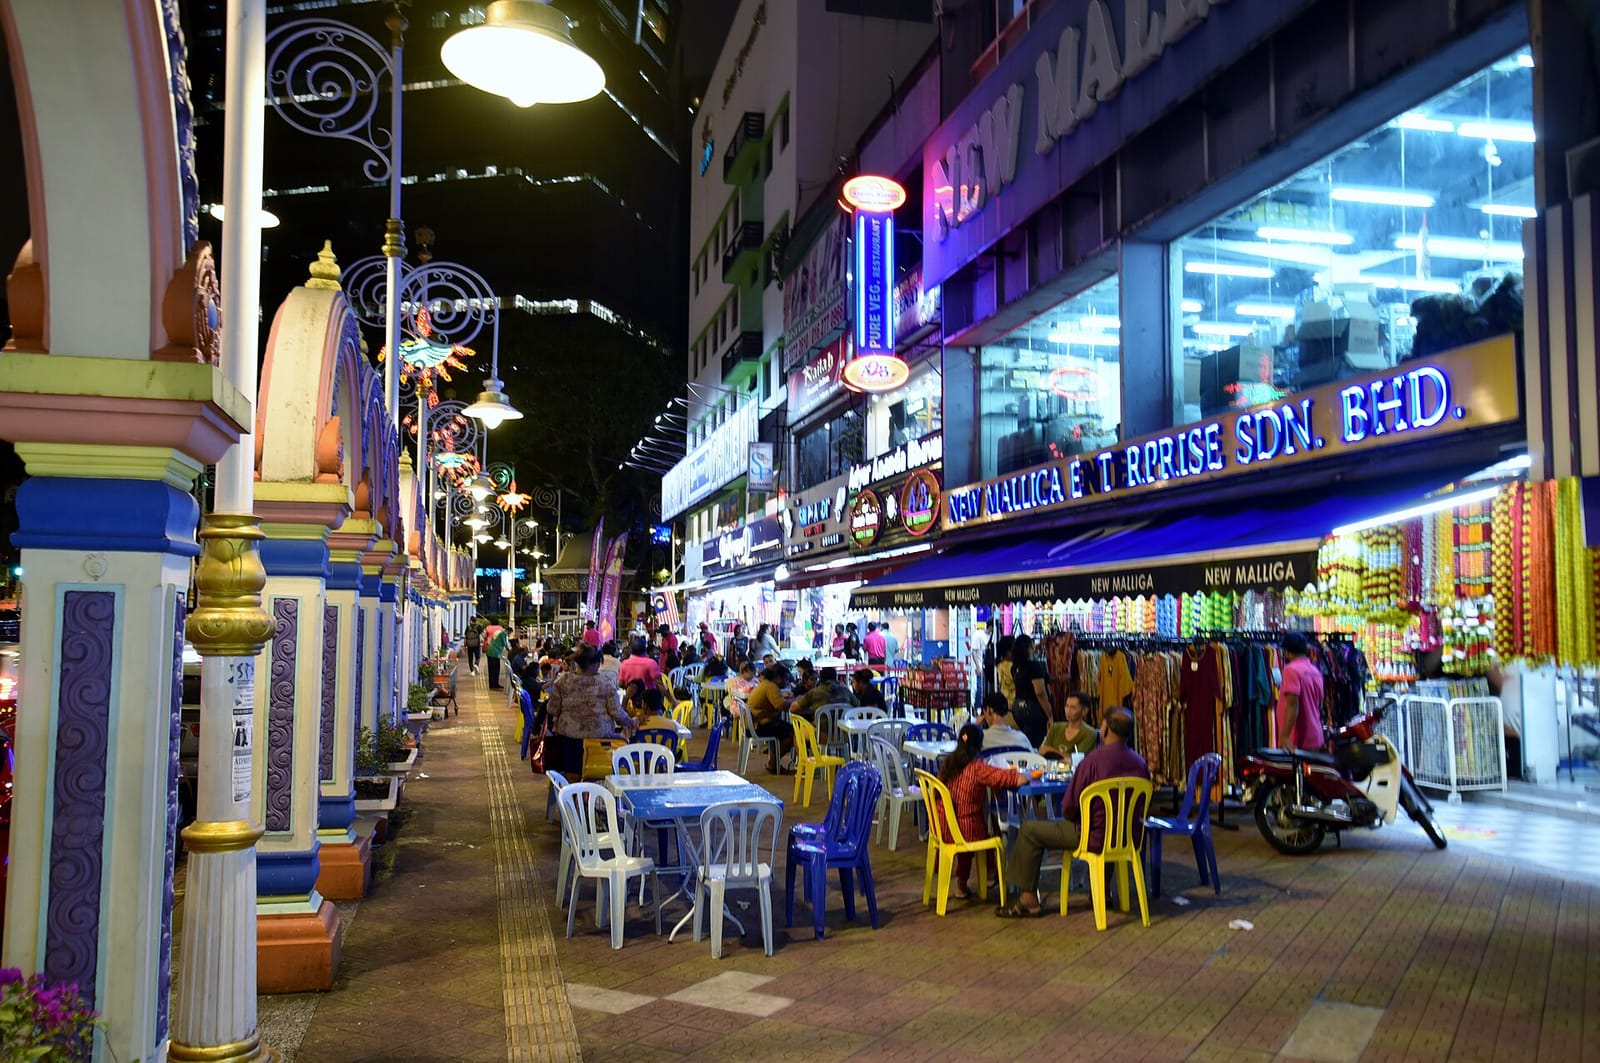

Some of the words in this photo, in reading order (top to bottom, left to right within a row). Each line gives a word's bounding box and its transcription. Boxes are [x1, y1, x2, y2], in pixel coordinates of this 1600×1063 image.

[932, 83, 1024, 243] NEW
[872, 218, 881, 278] RESTAURANT
[869, 314, 881, 349] PURE
[948, 488, 982, 524] NEW
[1235, 399, 1326, 465] SDN.
[1341, 365, 1466, 443] BHD.
[1007, 586, 1022, 599] NEW
[1023, 582, 1055, 598] MALLIGA
[1091, 578, 1110, 593] NEW
[1112, 573, 1154, 591] MALLIGA
[1205, 568, 1231, 586] NEW
[1235, 560, 1296, 585] MALLIGA
